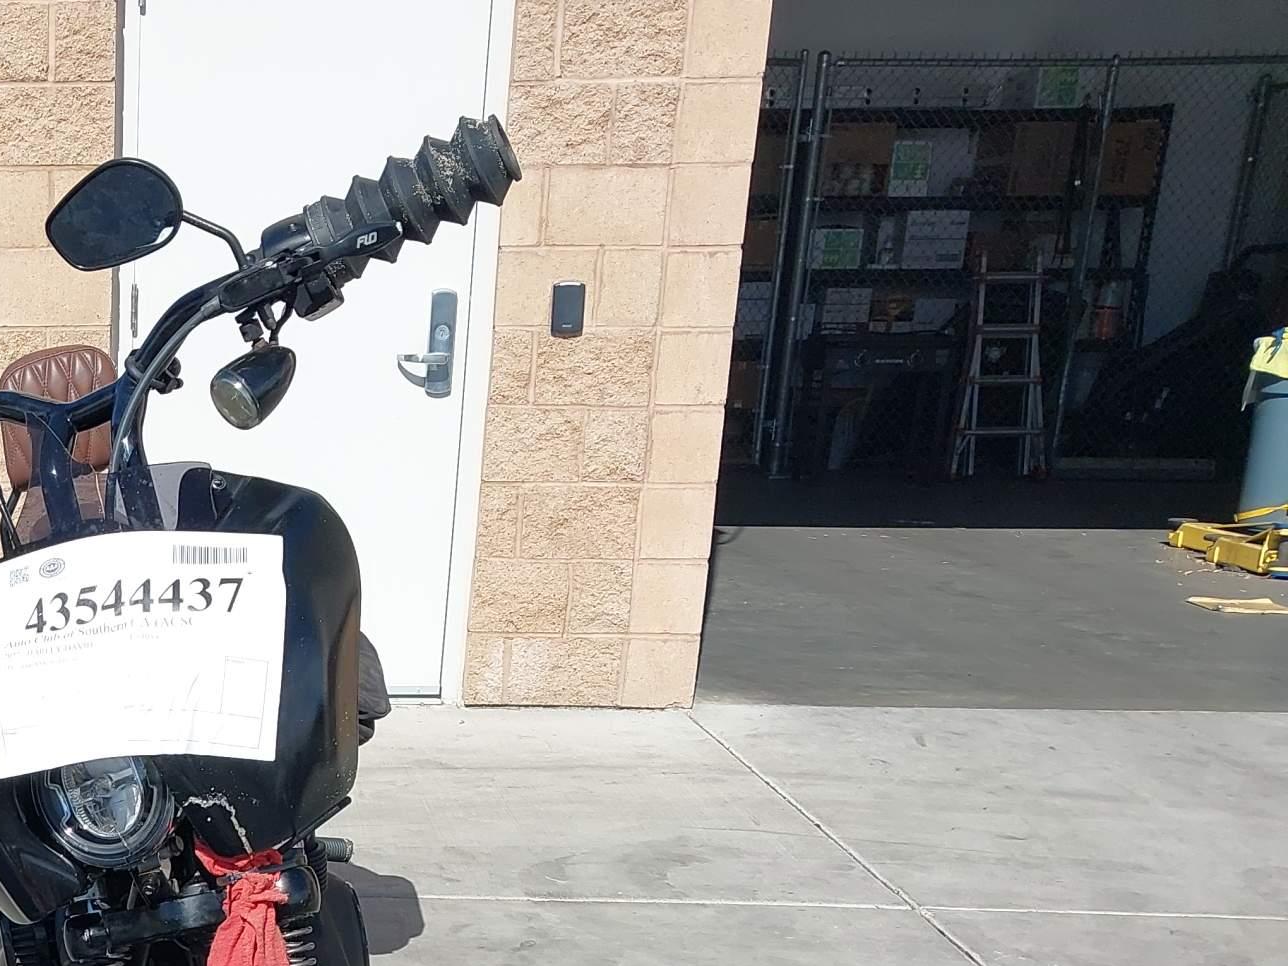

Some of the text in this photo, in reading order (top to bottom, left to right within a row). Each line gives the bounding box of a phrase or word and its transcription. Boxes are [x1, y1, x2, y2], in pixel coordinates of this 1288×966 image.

[24, 577, 244, 634] 43544437
[4, 638, 31, 649] Auto
[78, 621, 128, 637] Southern
